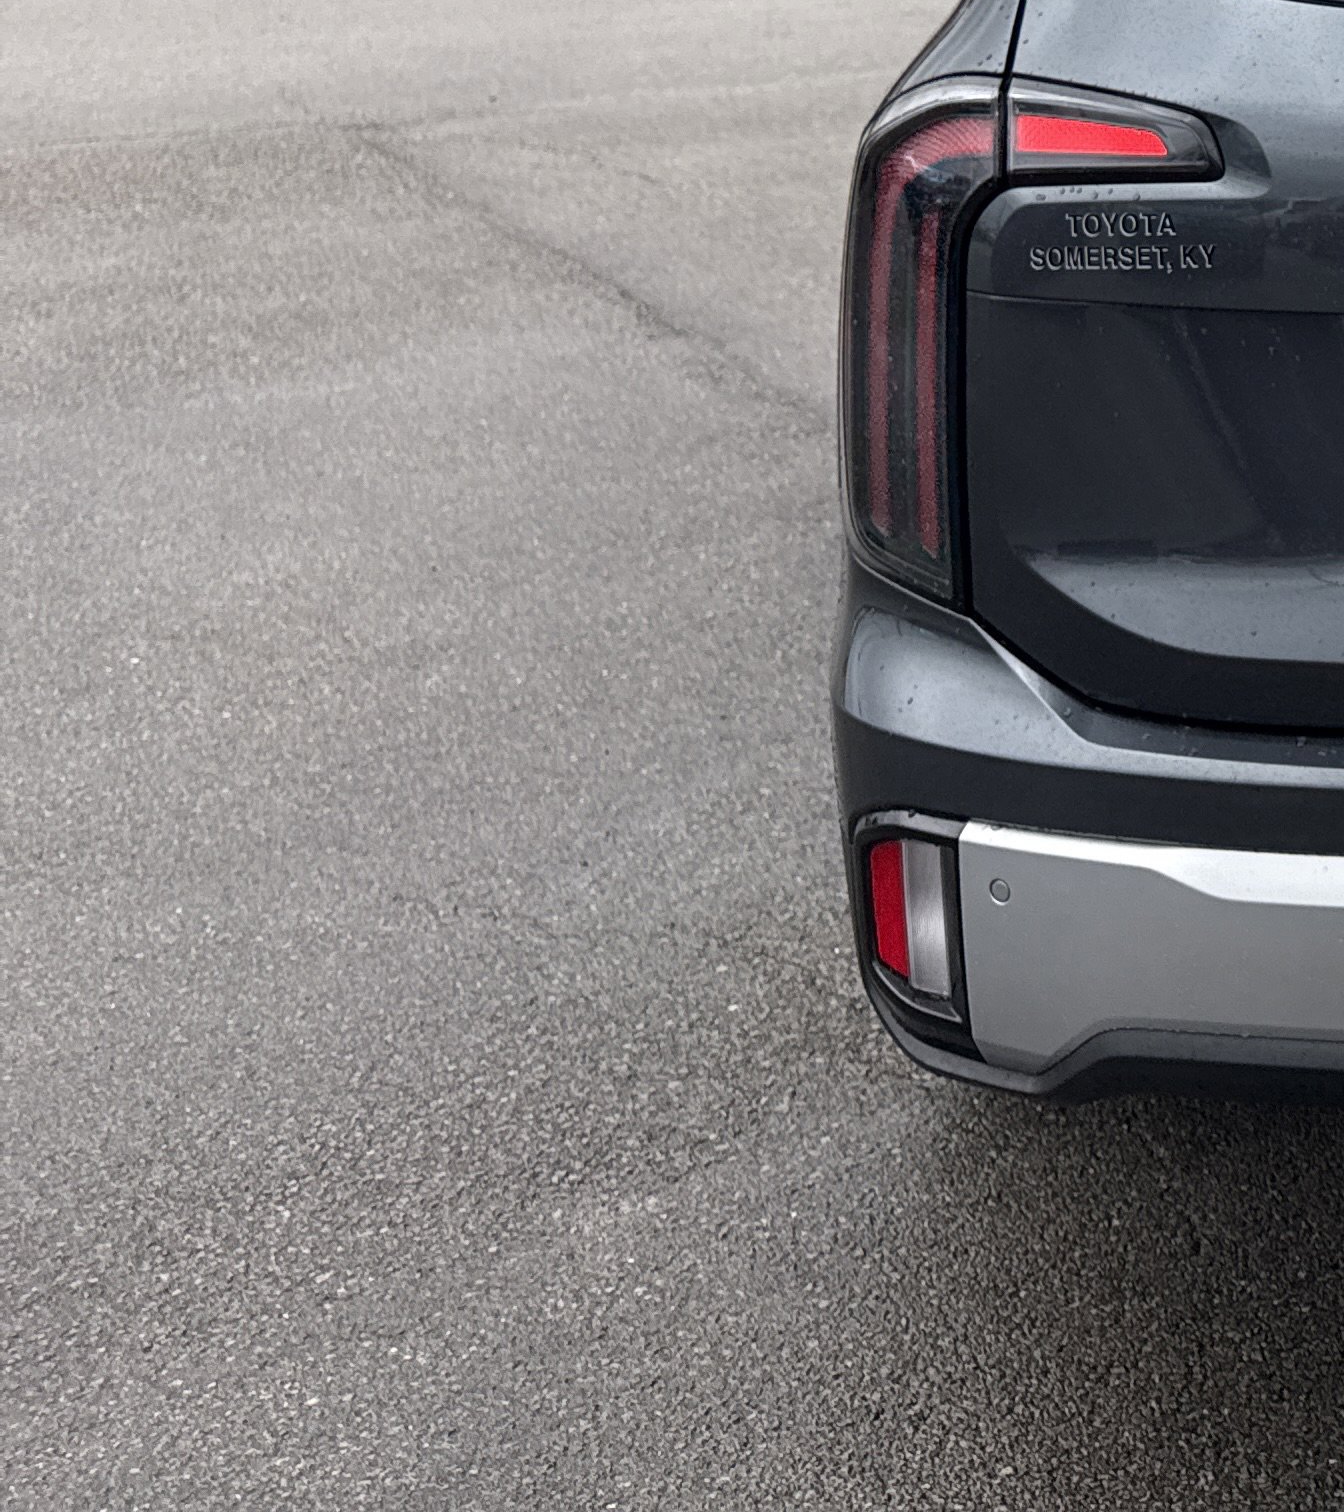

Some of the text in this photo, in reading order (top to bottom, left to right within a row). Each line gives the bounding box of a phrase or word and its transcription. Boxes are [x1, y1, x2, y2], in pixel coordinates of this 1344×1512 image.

[1065, 211, 1177, 238] TOYOTA
[1029, 243, 1217, 274] SOMERSET, KY
